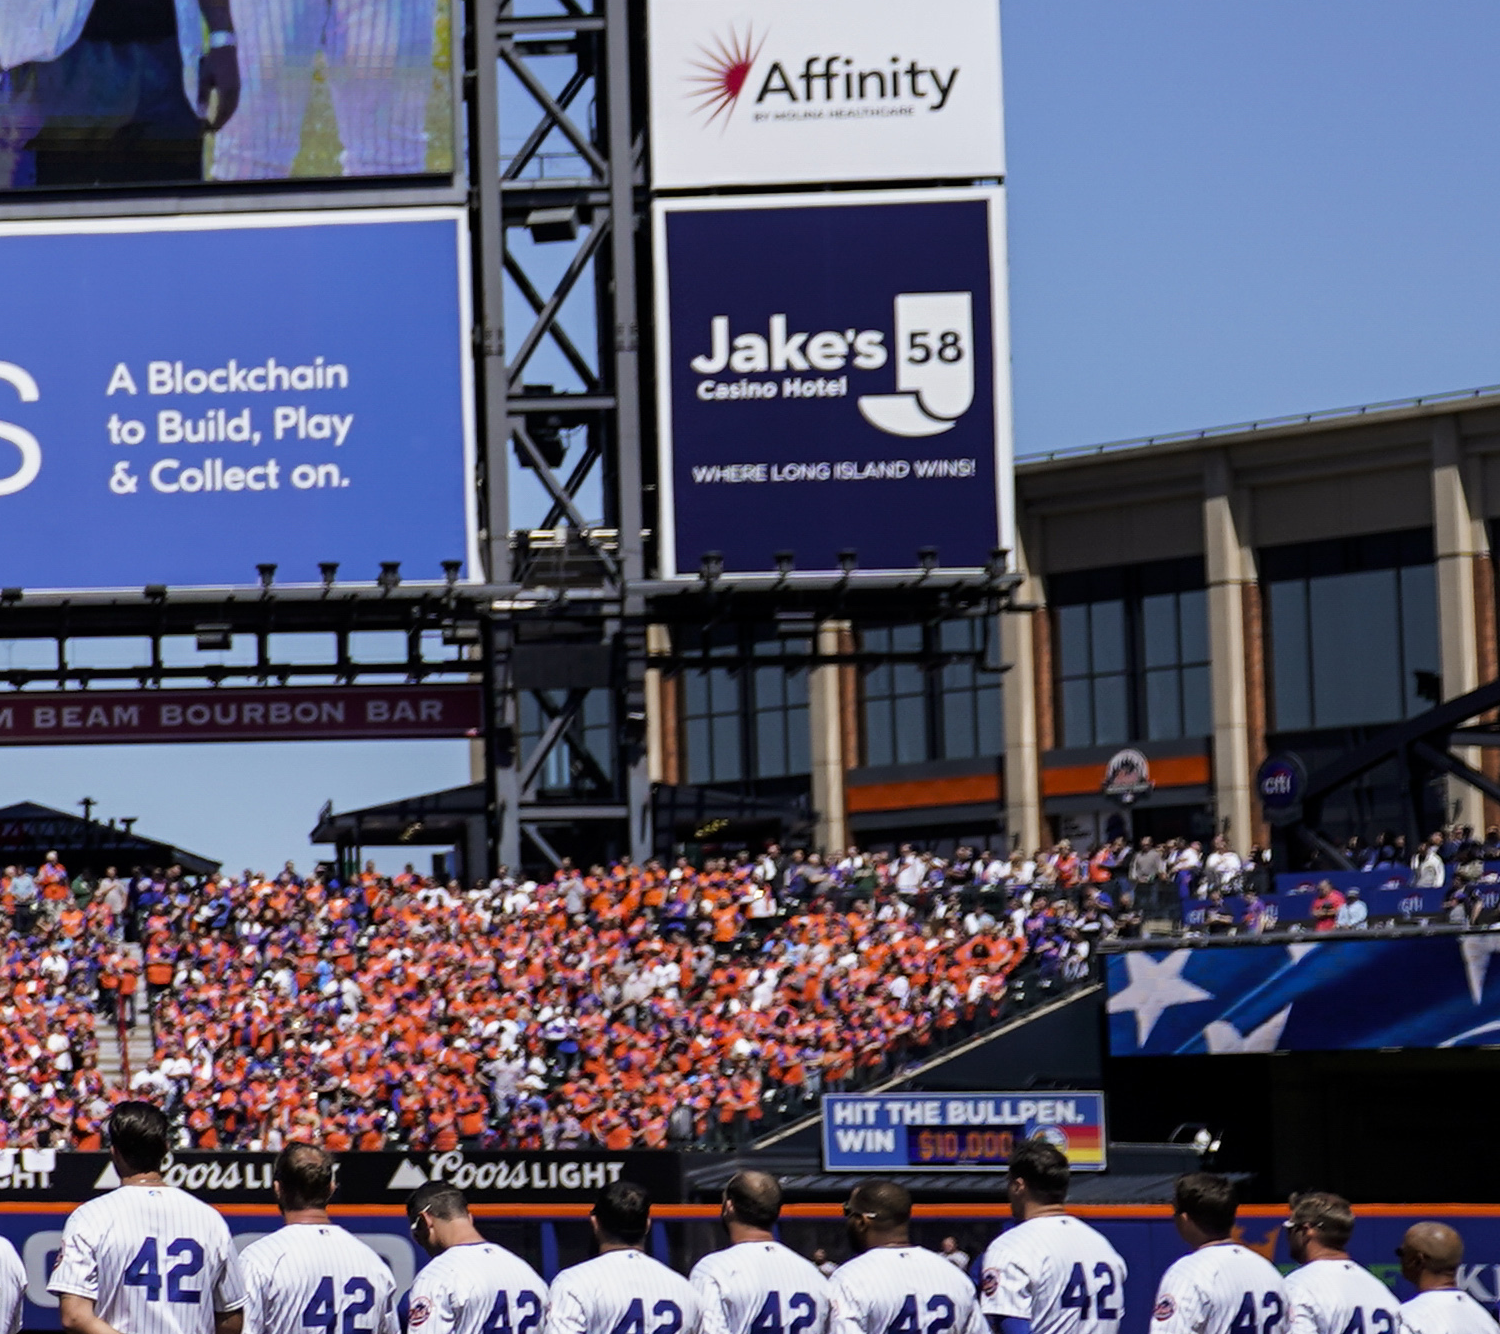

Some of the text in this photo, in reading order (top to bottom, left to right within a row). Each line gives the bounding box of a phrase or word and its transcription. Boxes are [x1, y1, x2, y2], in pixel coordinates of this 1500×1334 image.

[756, 55, 960, 111] Affinity
[690, 313, 889, 374] Jake's
[907, 331, 963, 365] 58
[106, 356, 349, 396] A Blockchain
[696, 375, 848, 401] Casino Hotel
[107, 405, 354, 447] to Build, Play
[109, 458, 350, 495] & Collect on.
[691, 458, 977, 484] WHERE LONG ISLAND WINS!
[33, 704, 141, 729] BEAM
[159, 701, 346, 727] BOURBON
[366, 699, 444, 723] BAR
[833, 1100, 1086, 1126] HIT THE BULLPEN.
[835, 1128, 1014, 1161] WIN $10,000
[428, 1151, 625, 1189] Coors LIGHT
[124, 1238, 203, 1303] 42
[1061, 1263, 1117, 1320] 42
